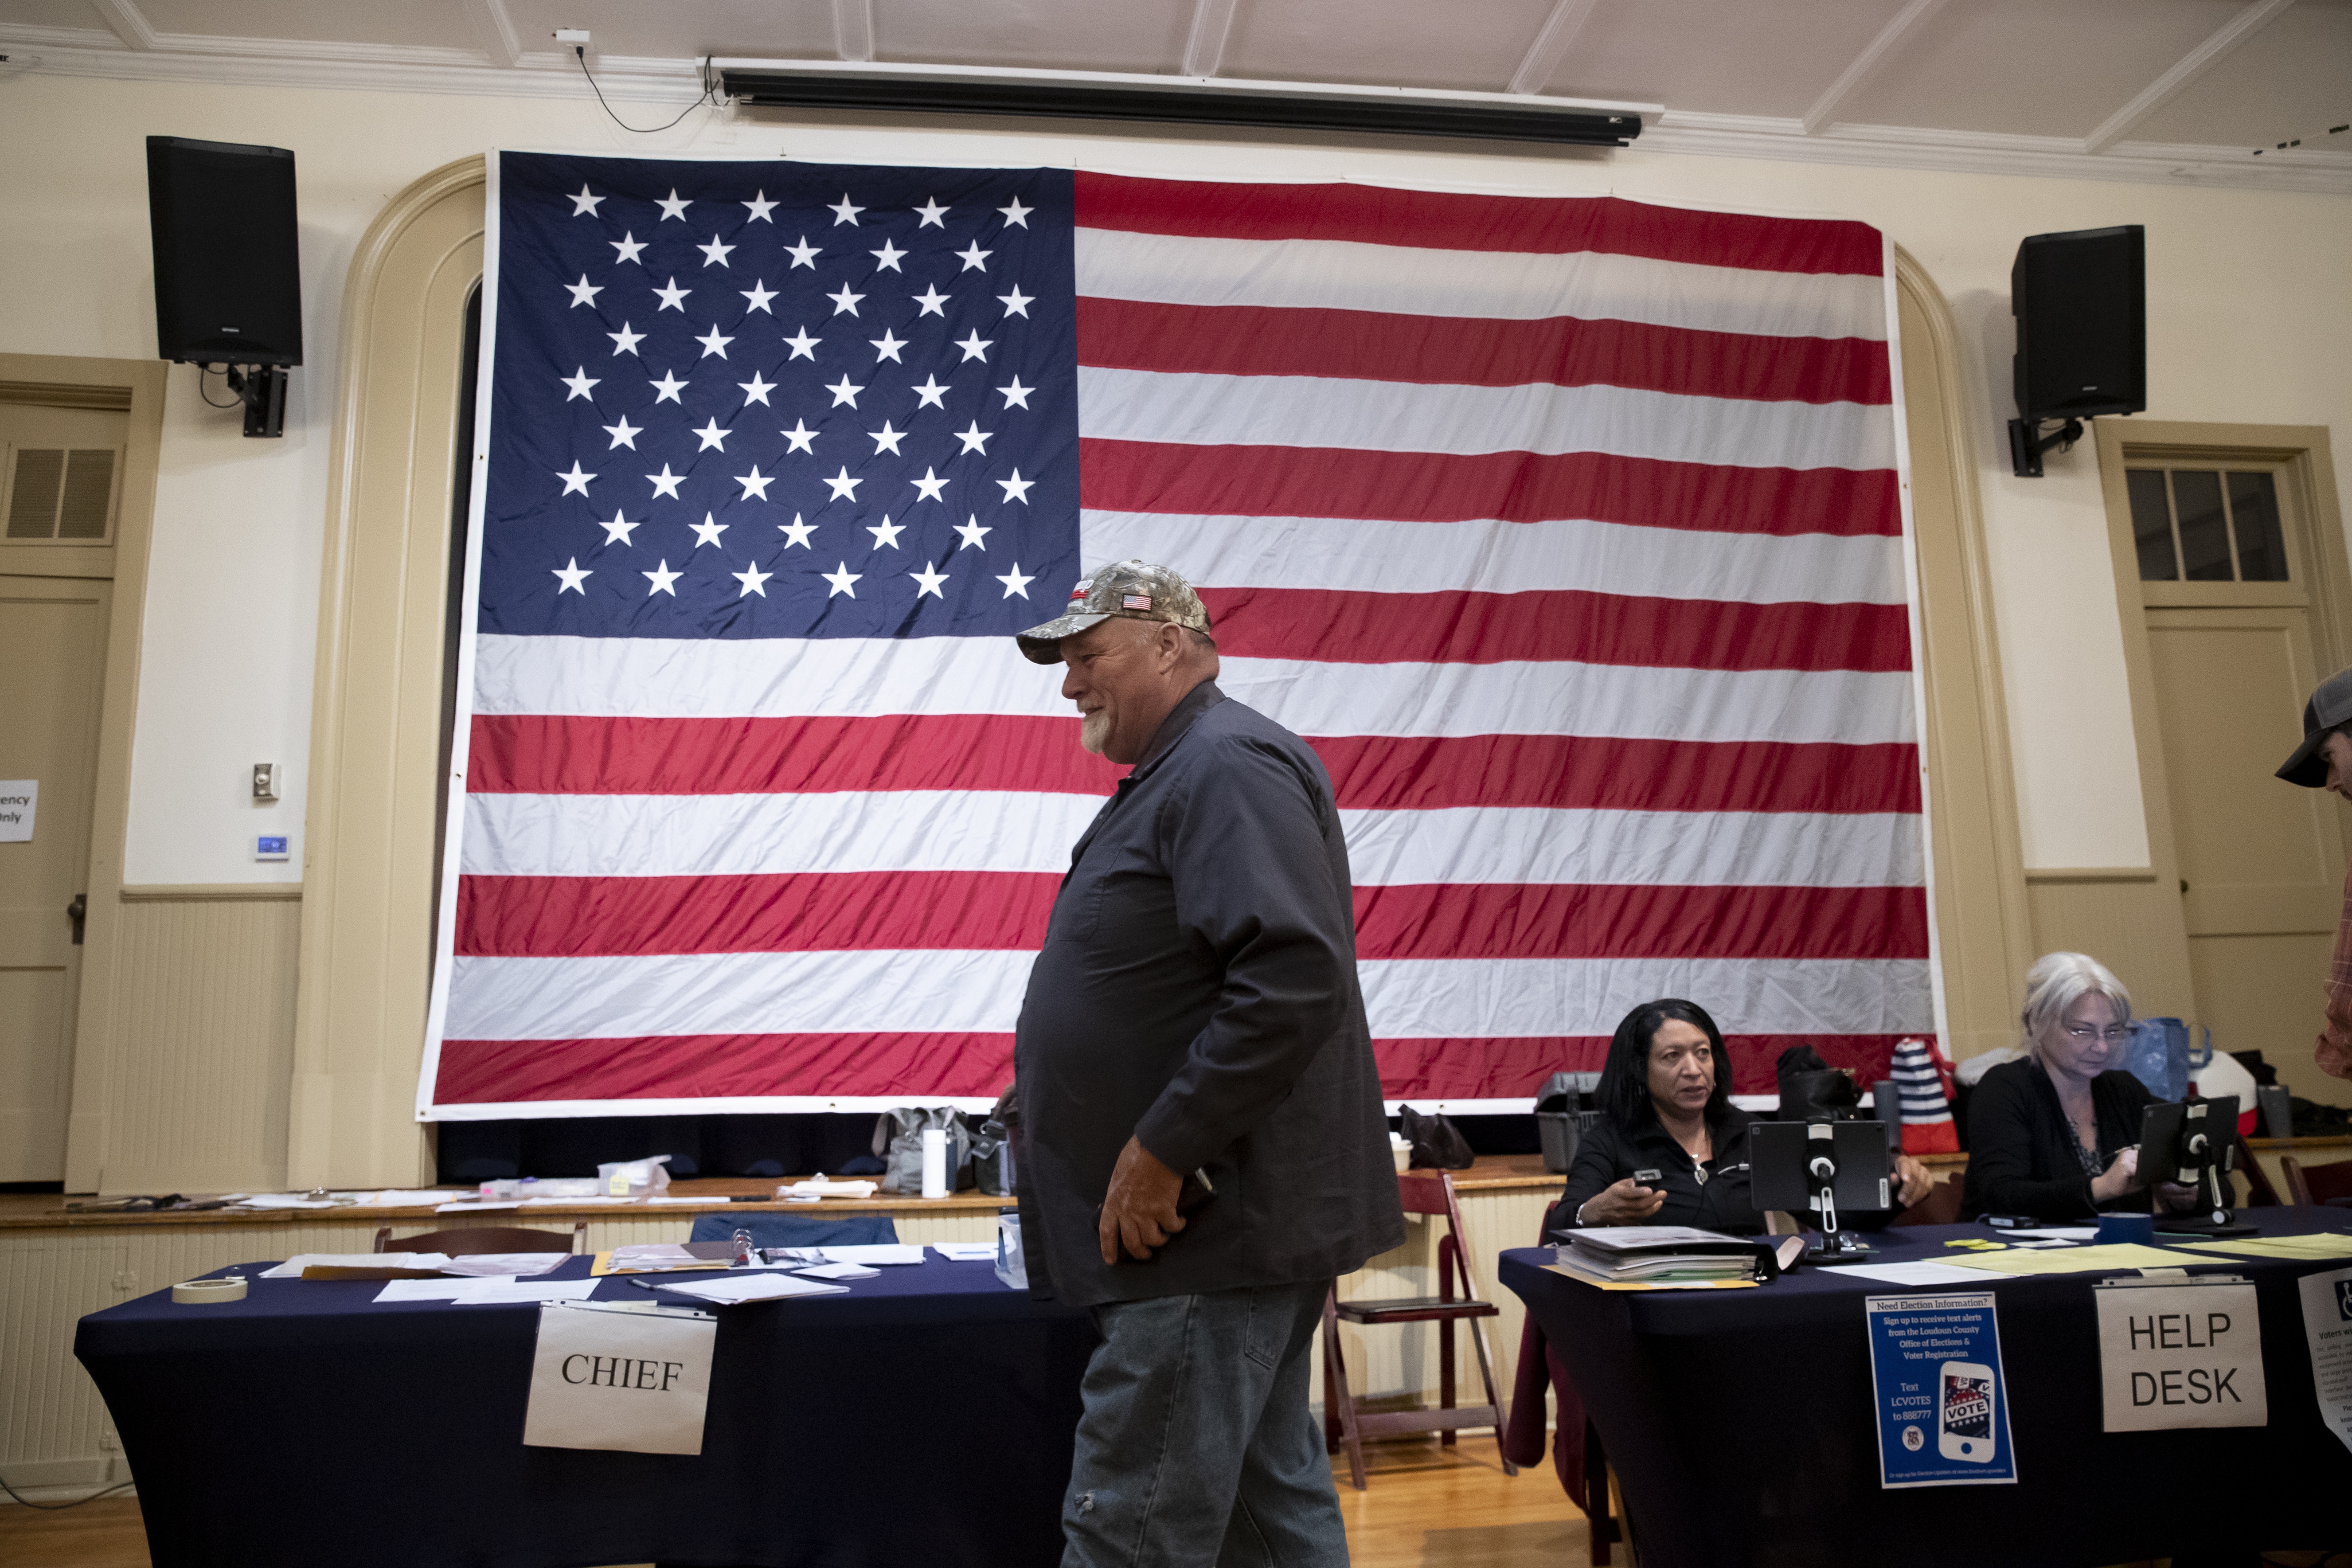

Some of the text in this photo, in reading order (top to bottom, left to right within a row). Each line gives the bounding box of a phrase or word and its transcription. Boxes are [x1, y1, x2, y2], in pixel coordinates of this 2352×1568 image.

[1877, 1298, 1988, 1310] Need Election Information?
[1884, 1317, 1899, 1326] Sign
[1962, 1314, 1982, 1322] alerts
[1920, 1327, 1952, 1335] Loudoun
[1953, 1326, 1980, 1334] County
[2129, 1313, 2231, 1350] HELP
[2319, 1330, 2342, 1340] Voters
[1899, 1340, 1921, 1348] Office
[1930, 1338, 1963, 1347] Elections
[1924, 1349, 1969, 1360] Registration
[562, 1354, 684, 1392] CHIEF
[1900, 1383, 1919, 1392] Text
[2131, 1368, 2242, 1407] DESK
[1891, 1396, 1931, 1407] LCVOTES
[1948, 1401, 1986, 1419] VOTE
